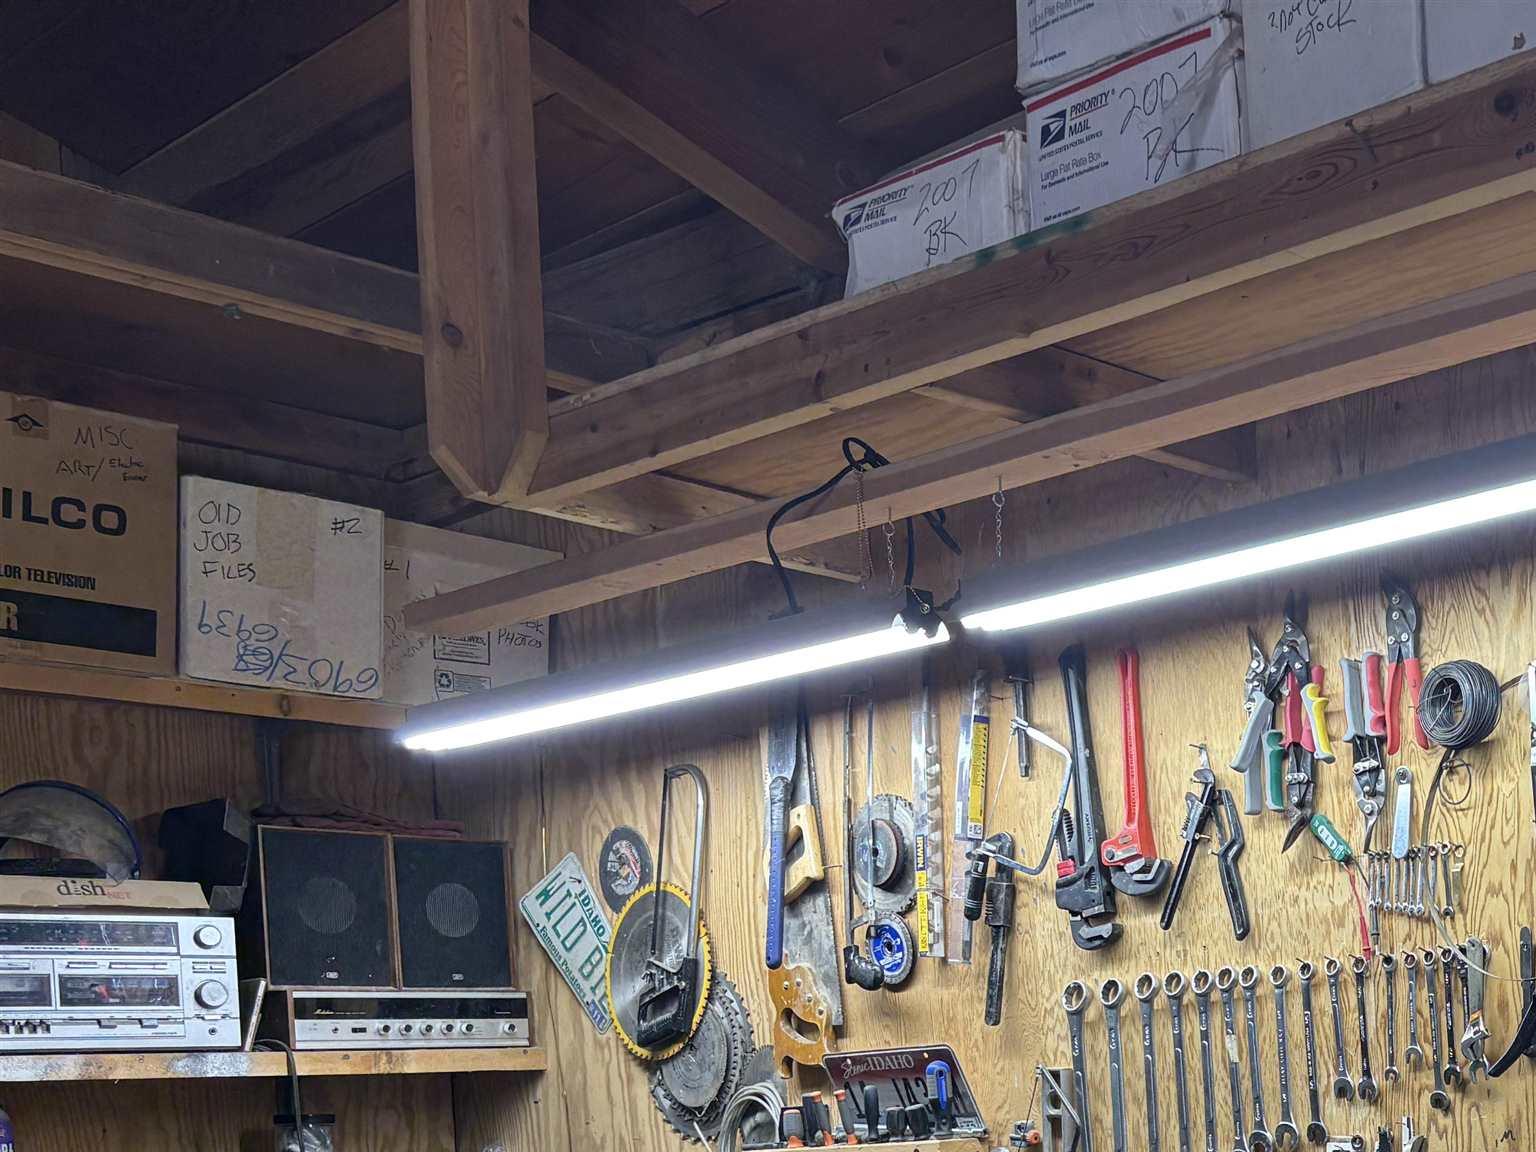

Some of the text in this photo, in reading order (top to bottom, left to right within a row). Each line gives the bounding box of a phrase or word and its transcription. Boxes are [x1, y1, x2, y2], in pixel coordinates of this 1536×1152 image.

[1066, 91, 1113, 117] PRIORITY
[1119, 52, 1199, 135] 2007
[1066, 119, 1092, 137] MAIL
[1038, 167, 1060, 184] Large
[1070, 155, 1088, 169] Rate
[1086, 149, 1102, 163] Box
[869, 185, 909, 207] PRIORITY
[913, 158, 980, 226] 2007
[864, 206, 887, 223] MAIL
[924, 212, 968, 266] BK
[74, 425, 133, 449] MISC
[2, 487, 127, 536] ILCO
[331, 517, 363, 536] #2
[194, 531, 241, 553] JOB
[26, 567, 96, 590] TELEVISION
[201, 561, 256, 582] FILES
[916, 835, 924, 867] IRWIN
[57, 879, 106, 896] dish
[535, 872, 588, 953] WILD
[577, 888, 606, 938] IDAHO
[540, 923, 587, 999] Famous Potatoes
[867, 1054, 914, 1072] IDAHO
